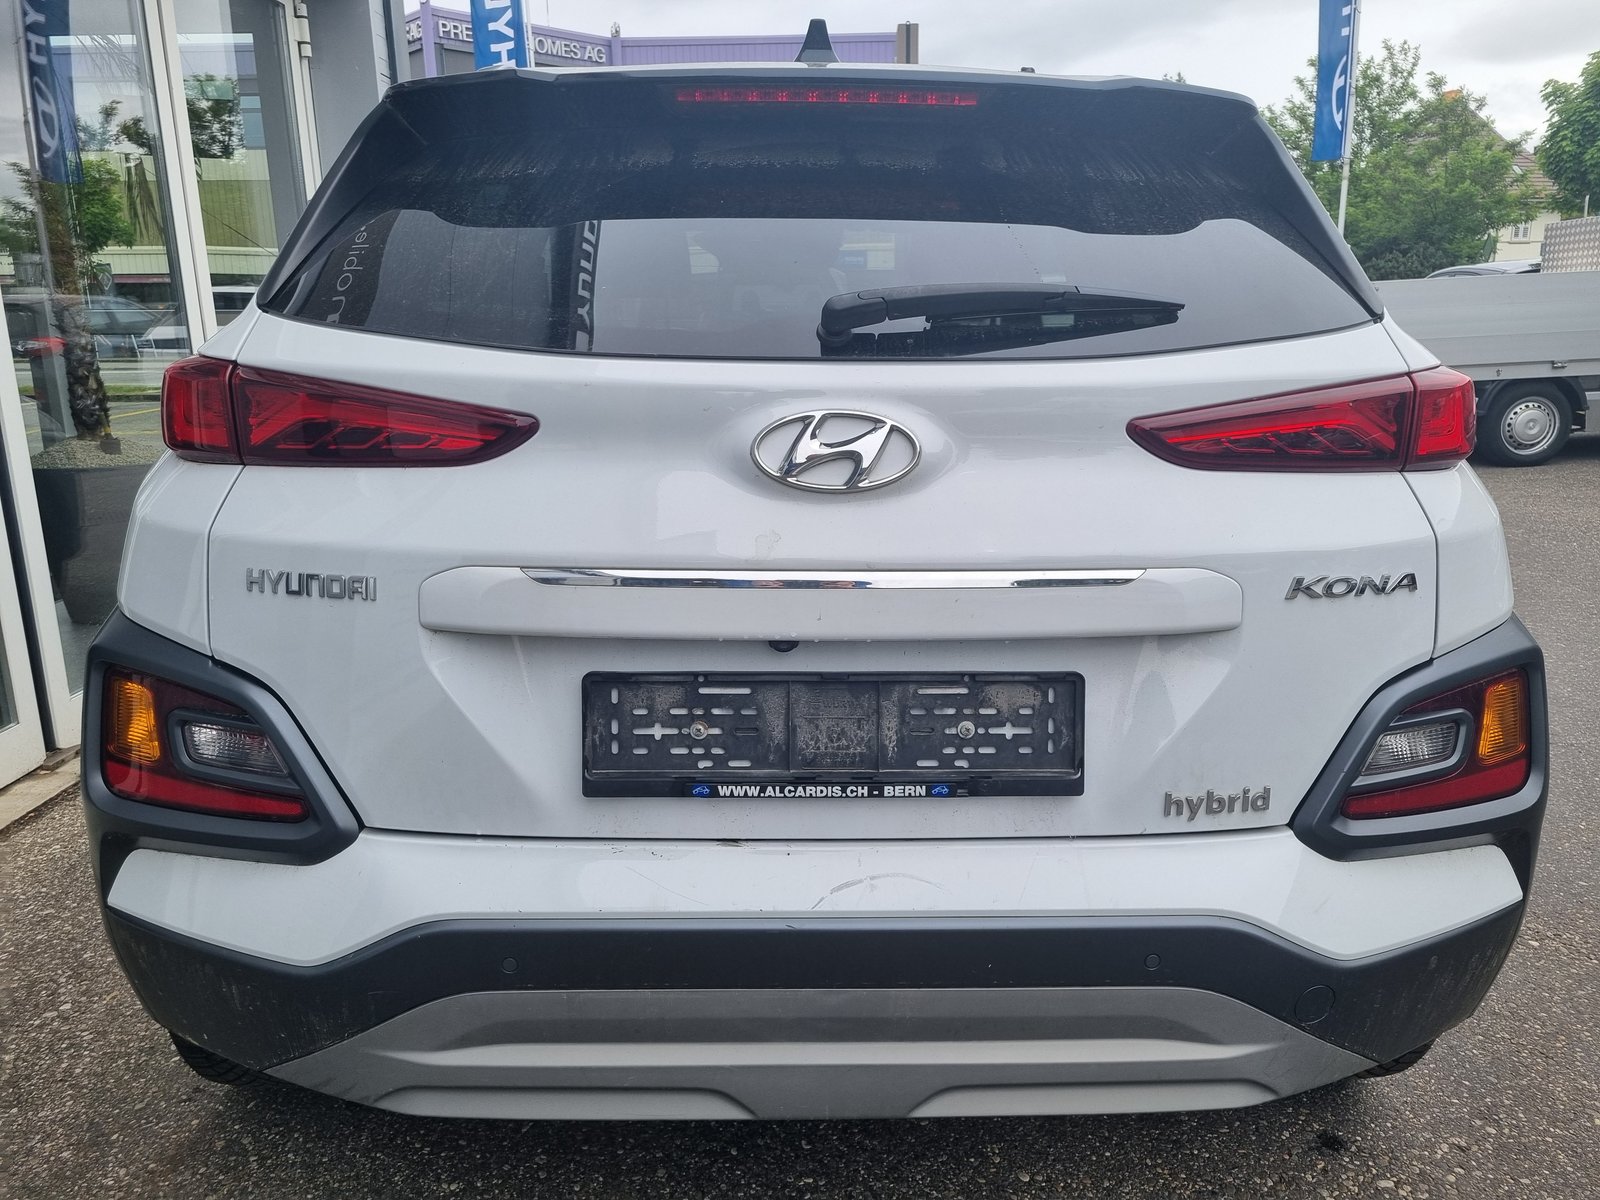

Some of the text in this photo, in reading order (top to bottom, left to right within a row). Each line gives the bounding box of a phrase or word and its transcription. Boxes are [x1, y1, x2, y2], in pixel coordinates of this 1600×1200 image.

[583, 45, 606, 63] AG
[246, 567, 377, 601] HYUNDAI
[1284, 571, 1418, 600] KONA
[717, 785, 868, 798] WWW.ALCARDIS.CH
[883, 785, 926, 797] BERN
[1163, 785, 1271, 822] hybrid
